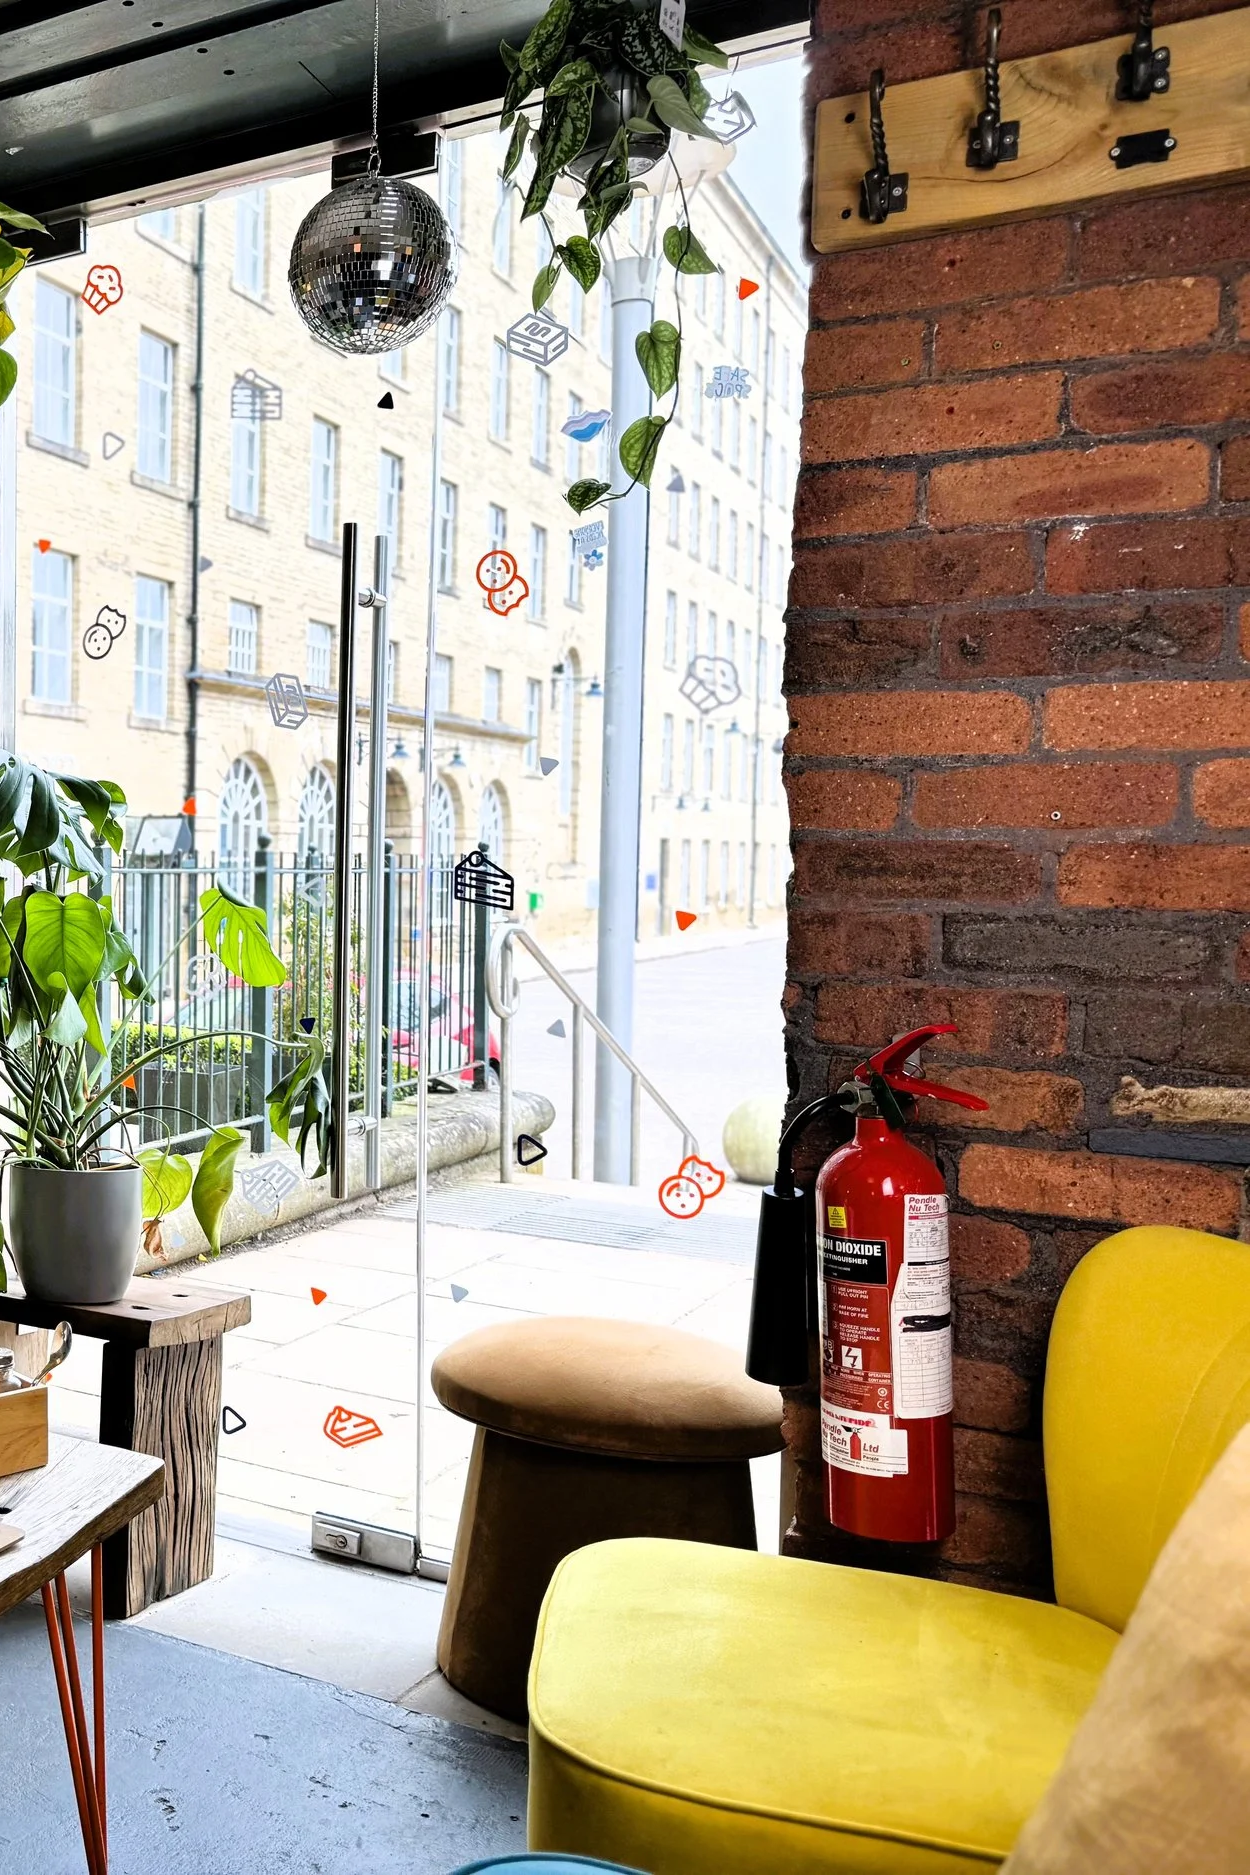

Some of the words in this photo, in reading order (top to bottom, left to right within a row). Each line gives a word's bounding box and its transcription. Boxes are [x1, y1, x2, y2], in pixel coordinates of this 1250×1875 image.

[908, 1196, 937, 1205] Pendle
[908, 1204, 921, 1212] Nu
[924, 1203, 940, 1212] Tech
[835, 1240, 882, 1257] DIOXIDE
[829, 1433, 847, 1447] Tech
[862, 1443, 879, 1453] Ltd
